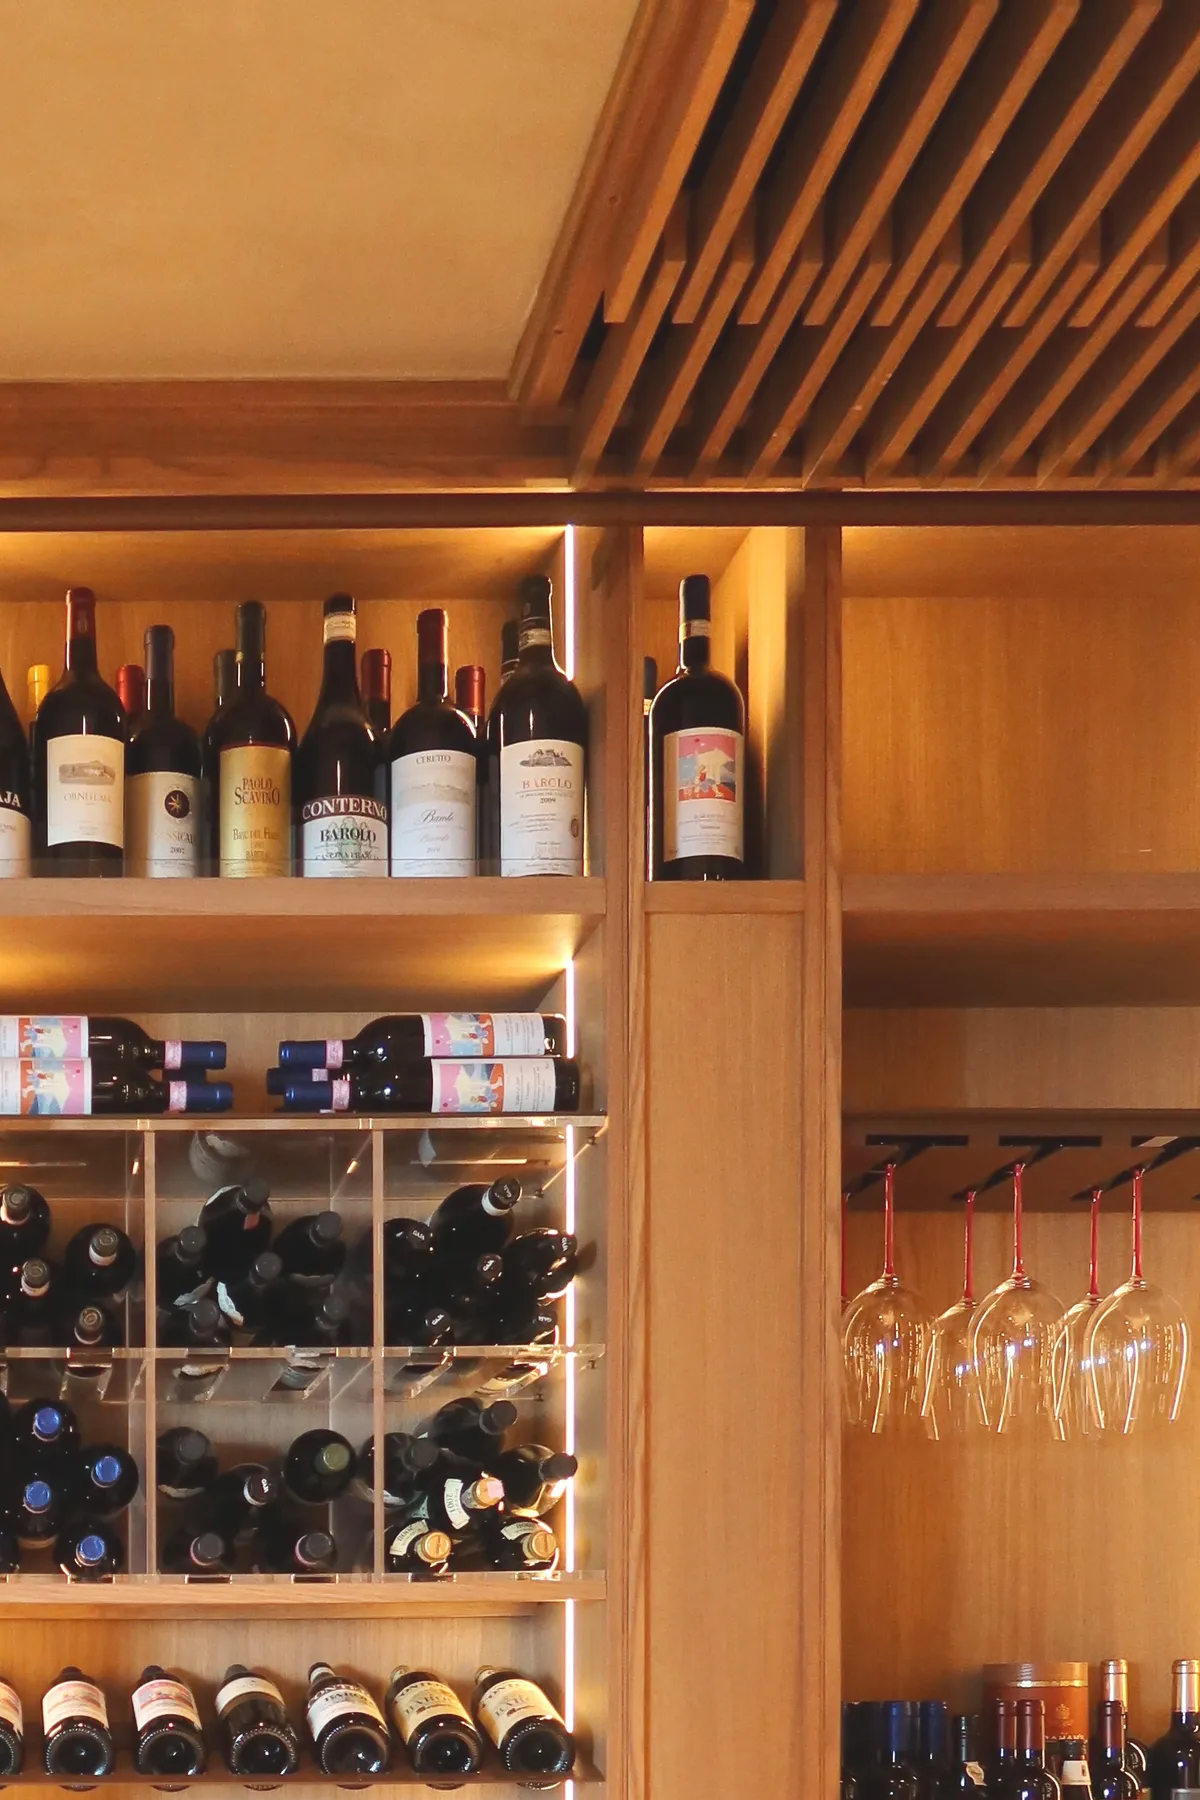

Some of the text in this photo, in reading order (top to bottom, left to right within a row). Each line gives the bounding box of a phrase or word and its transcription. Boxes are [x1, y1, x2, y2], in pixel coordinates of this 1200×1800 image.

[242, 777, 273, 791] PAOLO
[522, 777, 572, 790] BAROLO
[302, 797, 388, 820] CONTERNO
[320, 827, 377, 844] BAROLO
[431, 1313, 445, 1326] GAJA
